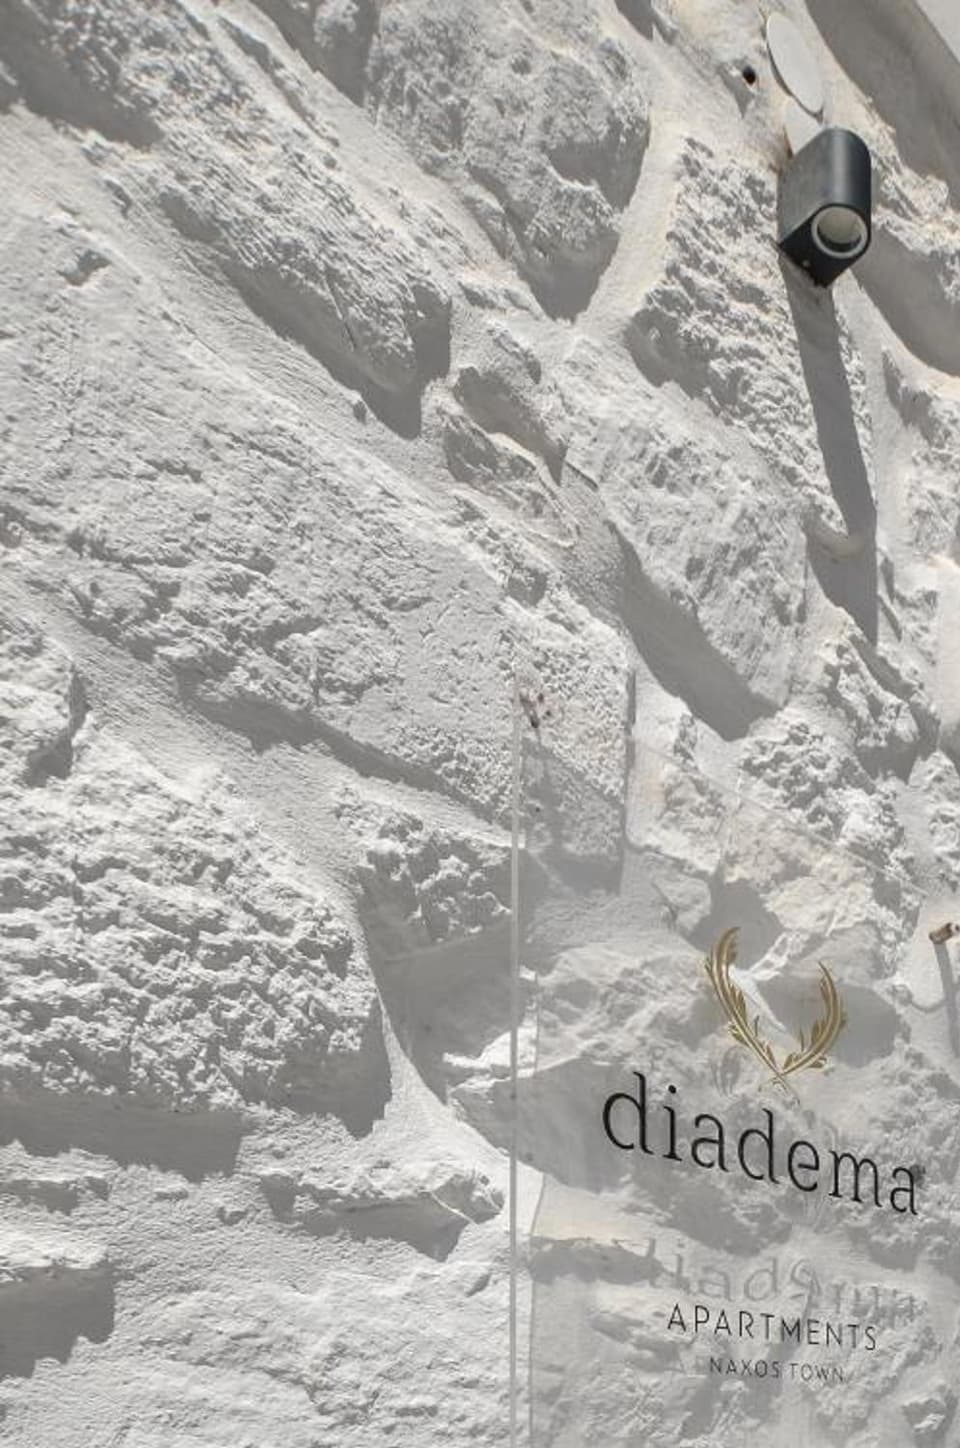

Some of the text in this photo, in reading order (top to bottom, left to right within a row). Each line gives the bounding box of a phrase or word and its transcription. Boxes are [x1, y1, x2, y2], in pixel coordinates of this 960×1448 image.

[602, 1071, 918, 1215] diadema
[667, 1303, 877, 1351] APARTMENTS
[709, 1357, 844, 1383] NAXOS TOWN
